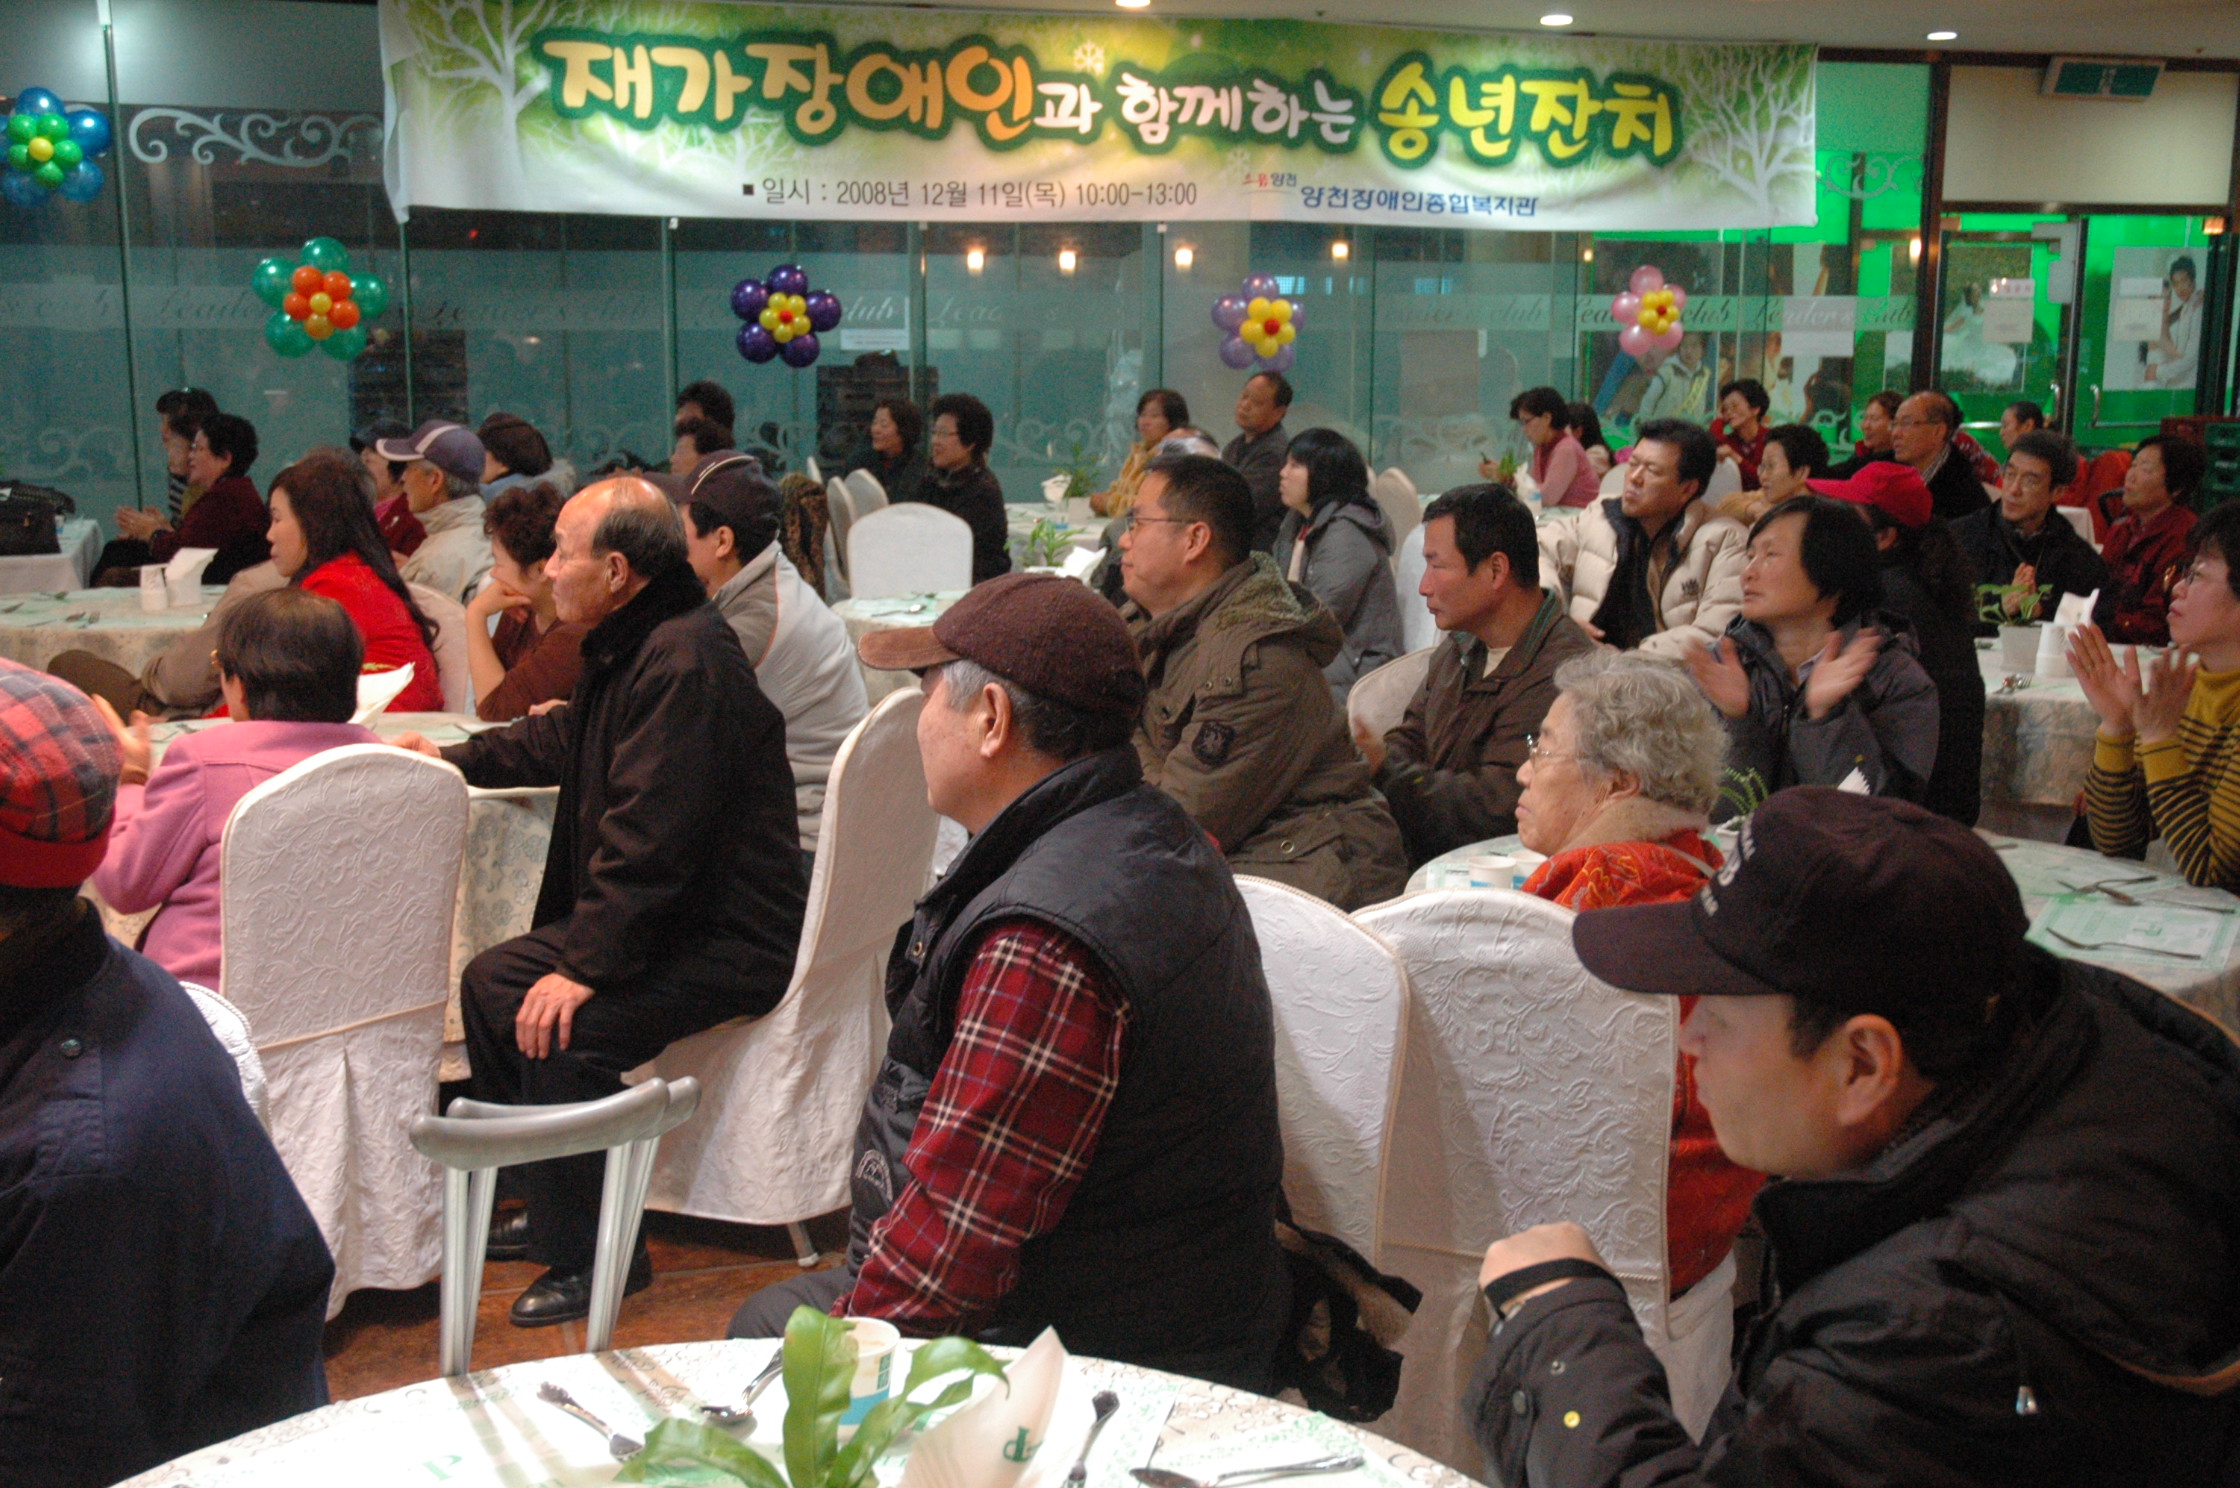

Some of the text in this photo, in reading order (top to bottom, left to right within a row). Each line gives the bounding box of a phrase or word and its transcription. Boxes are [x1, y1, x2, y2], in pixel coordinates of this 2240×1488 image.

[1116, 72, 1356, 145] 함께하는
[1379, 60, 1673, 161] 송년잔치
[762, 178, 810, 205] 일시
[836, 181, 910, 206] 2008년
[920, 182, 968, 207] 12월
[978, 181, 1066, 207] 11일(목)
[1075, 181, 1197, 206] 10:00-13:00
[1300, 185, 1539, 217] 양천장애인종합복지관
